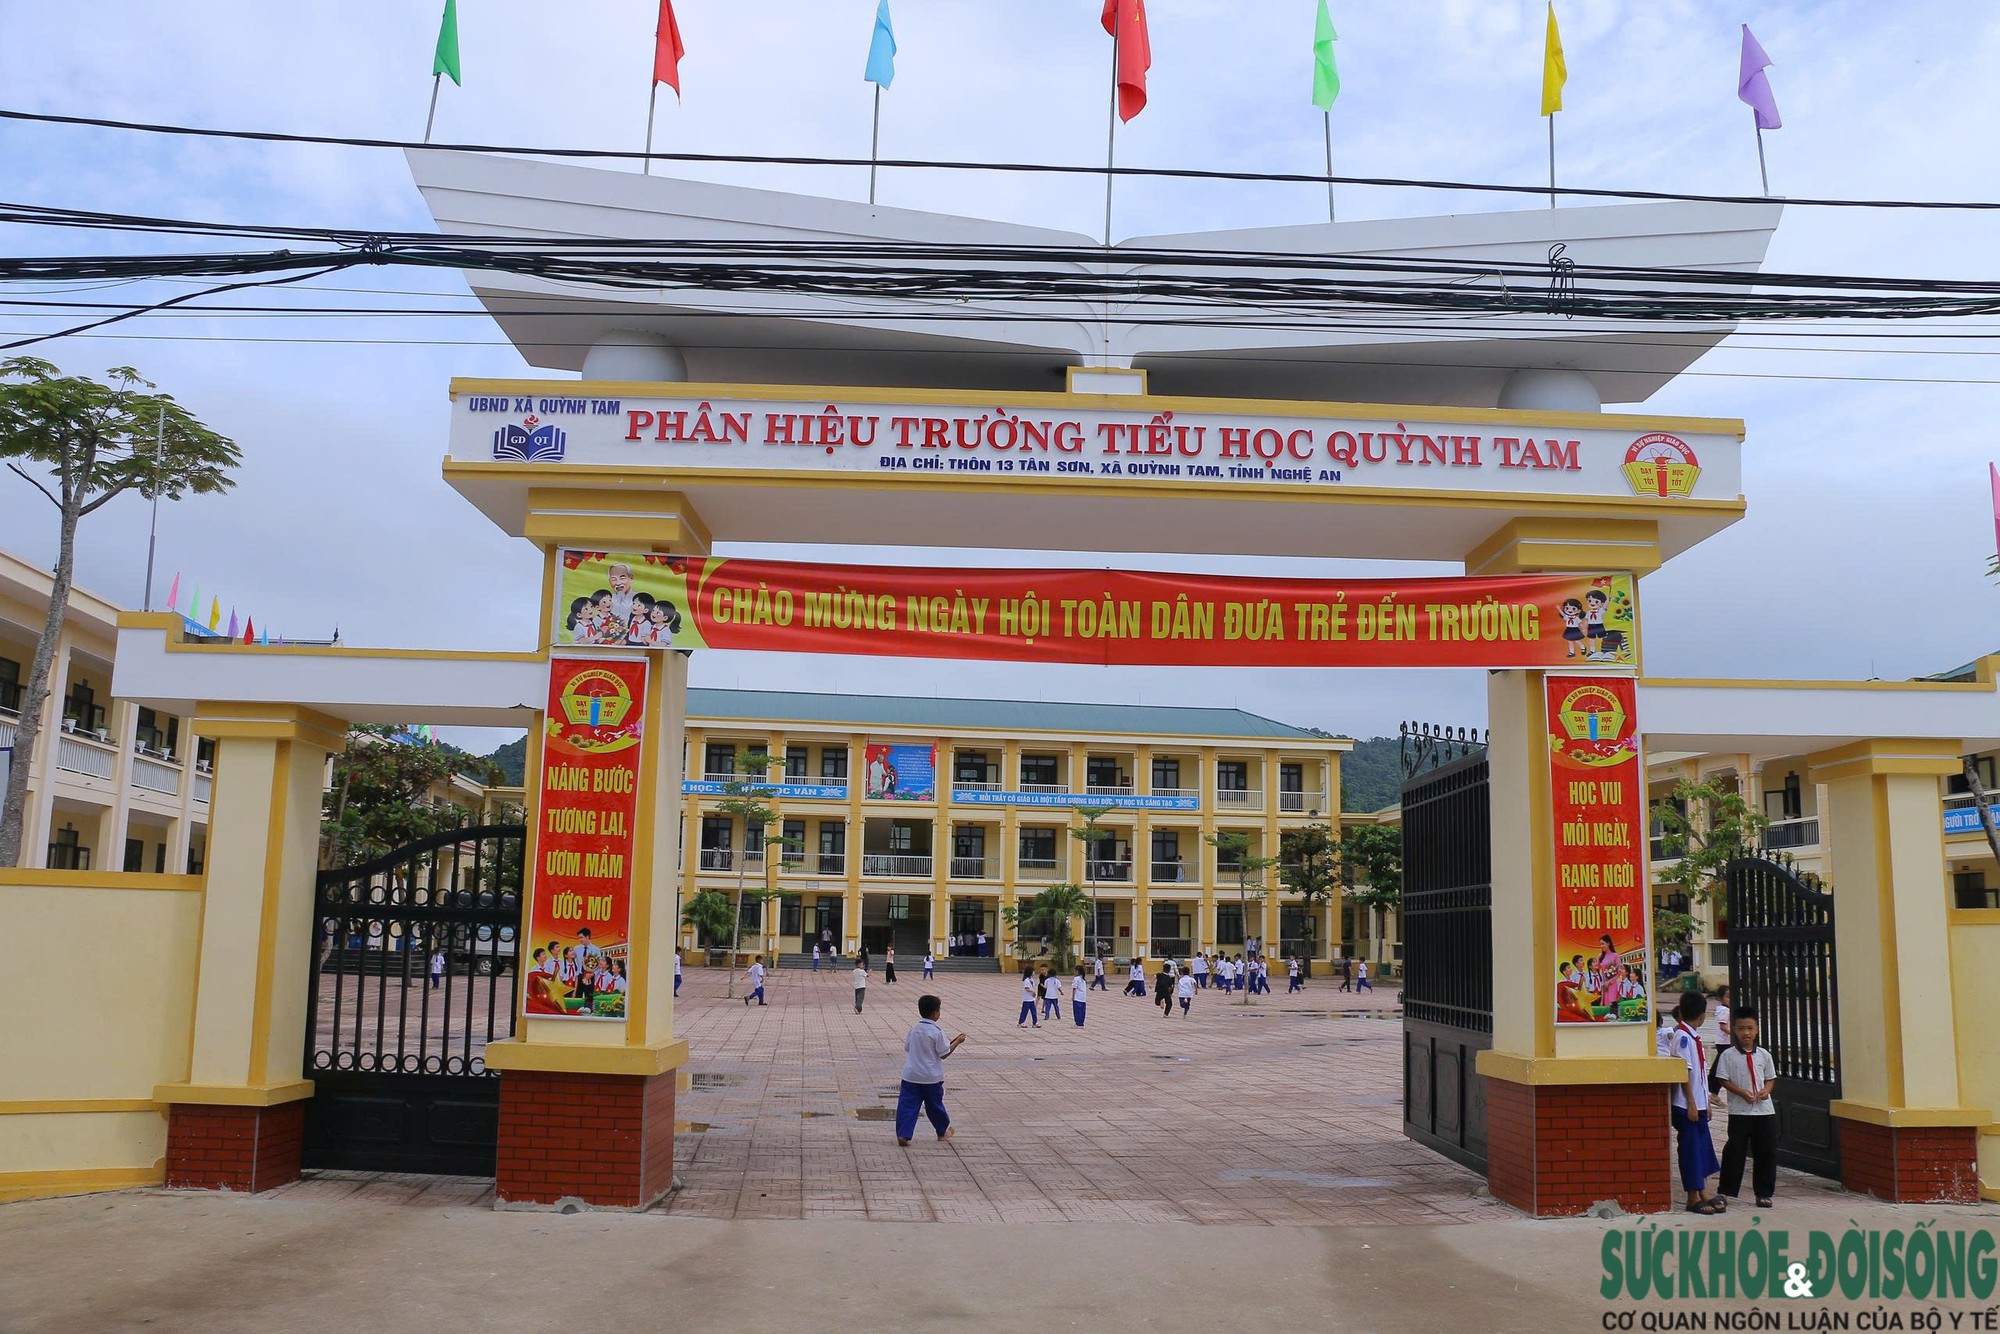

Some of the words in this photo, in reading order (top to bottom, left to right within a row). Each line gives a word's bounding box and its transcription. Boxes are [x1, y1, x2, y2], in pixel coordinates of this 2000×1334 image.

[470, 397, 509, 412] UBND
[514, 395, 533, 413] XÃ
[539, 396, 587, 415] QUỲNH
[591, 399, 621, 415] TAM
[511, 435, 527, 445] GD
[534, 436, 550, 446] QT
[625, 402, 752, 444] PHÂN
[763, 405, 880, 454] HIỆU
[891, 408, 1086, 453] TRƯỜNG
[1097, 411, 1206, 457] TIỂU
[1218, 427, 1314, 468] HỌC
[1327, 422, 1483, 469] QUỲNH
[1493, 437, 1582, 470] TAM
[880, 457, 907, 470] ĐỊA
[912, 454, 944, 469] CHỈ:
[949, 456, 991, 471] THÔN
[997, 459, 1013, 471] 13
[1019, 457, 1050, 472] TÂN
[1056, 460, 1095, 474] SƠN,
[1101, 460, 1122, 474] XÃ
[1127, 460, 1181, 476] QUỲNH
[1186, 464, 1225, 478] TAM,
[1228, 463, 1264, 479] TỈNH
[1271, 465, 1312, 483] NGHỆ
[1318, 469, 1341, 482] AN
[712, 582, 794, 627] CHÀO
[804, 585, 896, 631] MỪNG
[906, 589, 990, 635] NGÀY
[999, 590, 1050, 644] HỘI
[1060, 592, 1141, 639] TOÀN
[1151, 593, 1214, 640] DÂN
[1223, 598, 1285, 641] ĐƯA
[1294, 591, 1347, 641] TRẺ
[1357, 592, 1416, 642] ĐẾN
[1425, 595, 1540, 642] TRƯỜNG
[547, 762, 590, 792] NÂNG
[593, 764, 634, 794] BƯỚC
[690, 784, 713, 793] HỌC
[794, 787, 817, 796] VĂN
[1007, 794, 1016, 802] CÔ
[1017, 794, 1031, 803] GIÁO
[1032, 795, 1039, 803] LÀ
[1123, 799, 1136, 807] HỌC
[1136, 798, 1144, 806] VÀ
[1145, 798, 1160, 806] SÁNG
[1162, 799, 1173, 808] TẠO
[1569, 781, 1597, 810] HỌC
[1600, 781, 1622, 805] VUI
[547, 807, 597, 834] TƯƠNG
[600, 811, 627, 839] LAI,
[1562, 814, 1590, 846] MỖI
[1593, 817, 1631, 849] NGÀY,
[1963, 810, 1980, 827] TRỞ
[546, 849, 581, 877] ƯƠM
[585, 845, 624, 879] MẦM
[1561, 864, 1600, 893] RẠNG
[1603, 858, 1635, 888] NGỜI
[552, 890, 583, 920] ƯỚC
[586, 894, 613, 922] MƠ
[1569, 896, 1600, 930] TUỔI
[1604, 903, 1629, 930] THƠ
